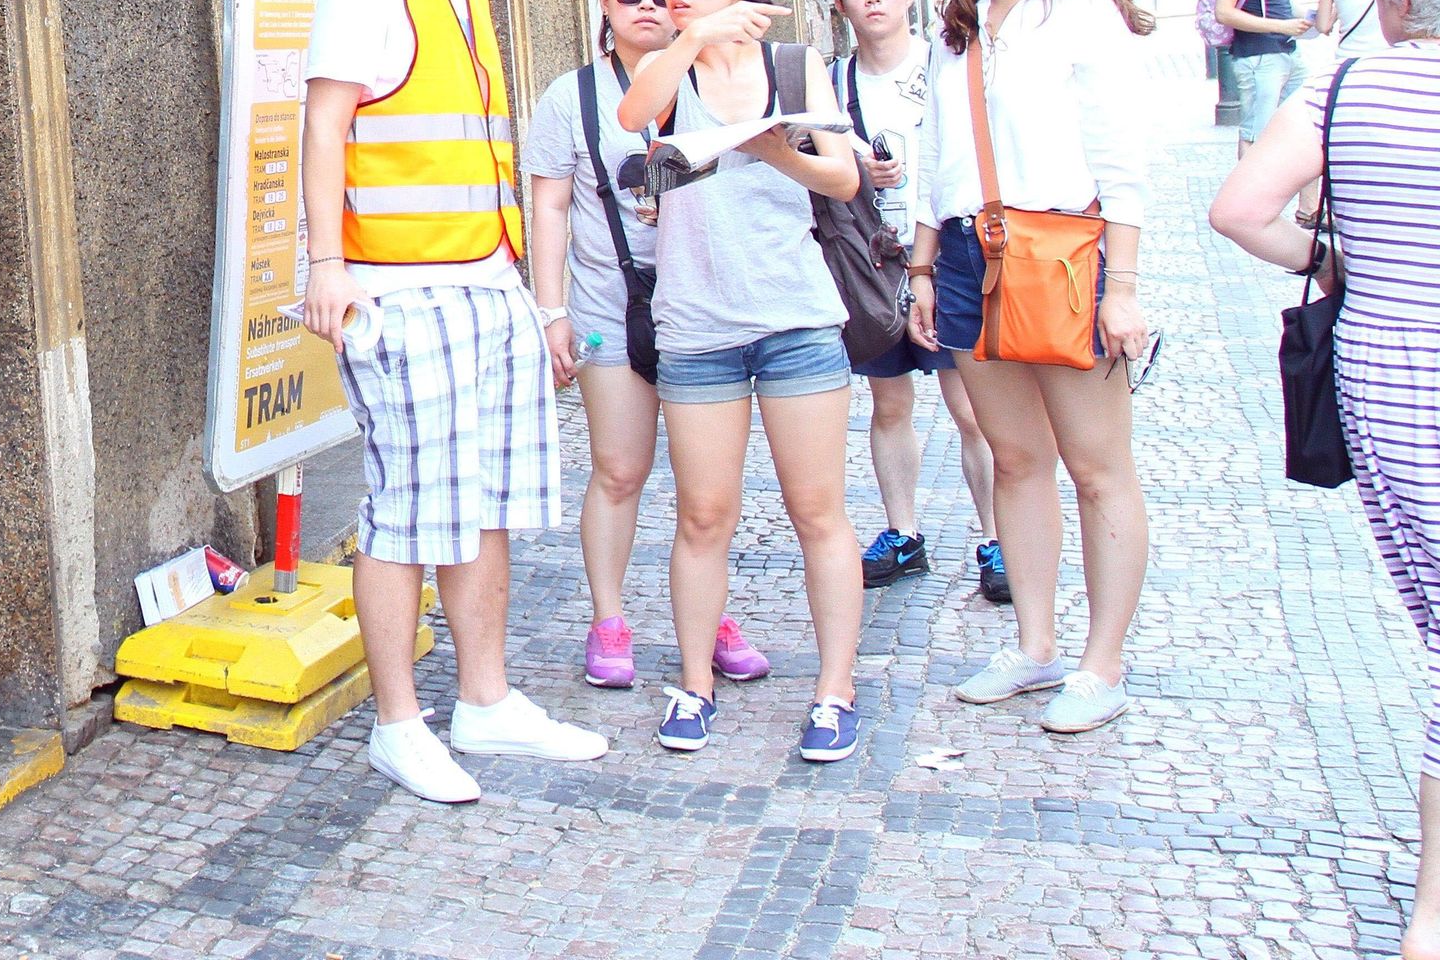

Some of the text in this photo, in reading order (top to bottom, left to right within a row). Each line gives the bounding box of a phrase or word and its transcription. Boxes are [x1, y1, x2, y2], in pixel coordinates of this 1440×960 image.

[254, 146, 289, 161] Malostranská
[253, 176, 284, 191] Hradčanská
[252, 207, 275, 223] Dejvická
[251, 257, 271, 271] Můstek
[246, 335, 301, 359] Substitute transport
[245, 358, 285, 379] Ersatzverkehr
[244, 370, 304, 429] TRAM
